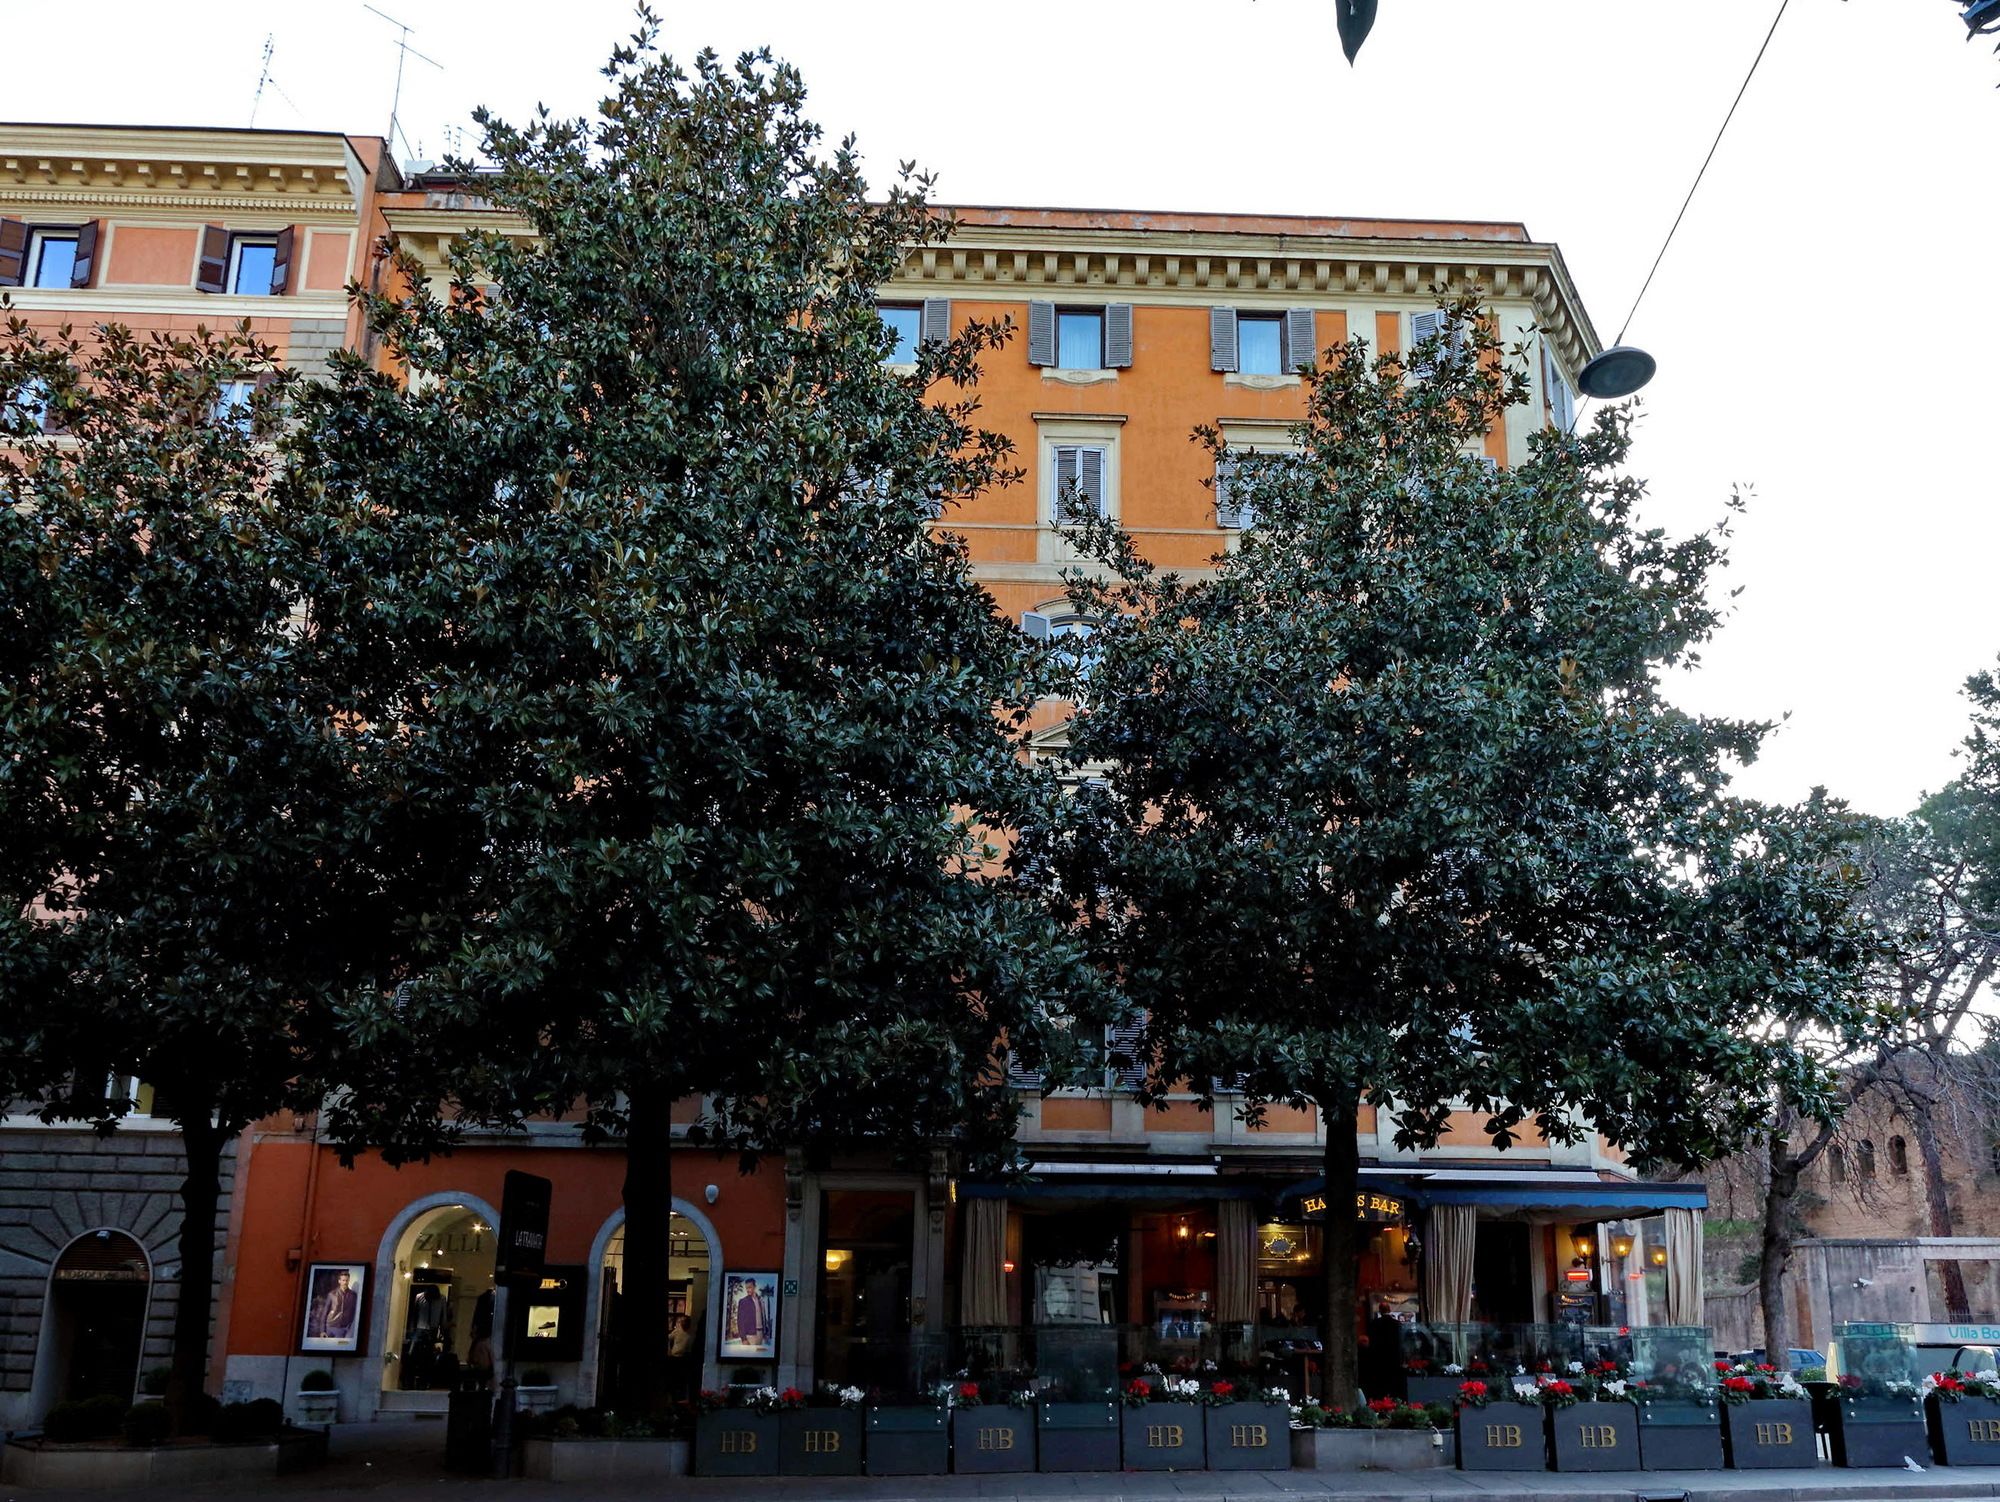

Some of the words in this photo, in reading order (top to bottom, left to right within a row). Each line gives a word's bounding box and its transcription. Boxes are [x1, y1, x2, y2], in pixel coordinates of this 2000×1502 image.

[1370, 1197, 1400, 1214] BAR
[417, 1233, 482, 1252] ZILLI
[1948, 1327, 1978, 1339] Villa
[804, 1430, 840, 1452] HB
[978, 1428, 1014, 1450] HB
[1147, 1426, 1183, 1447] HB
[1232, 1425, 1268, 1447] HB
[1486, 1425, 1522, 1447] HB
[1580, 1426, 1617, 1447] HB
[1755, 1423, 1793, 1445] HB
[1968, 1420, 2000, 1441] HB
[721, 1431, 757, 1453] HB
